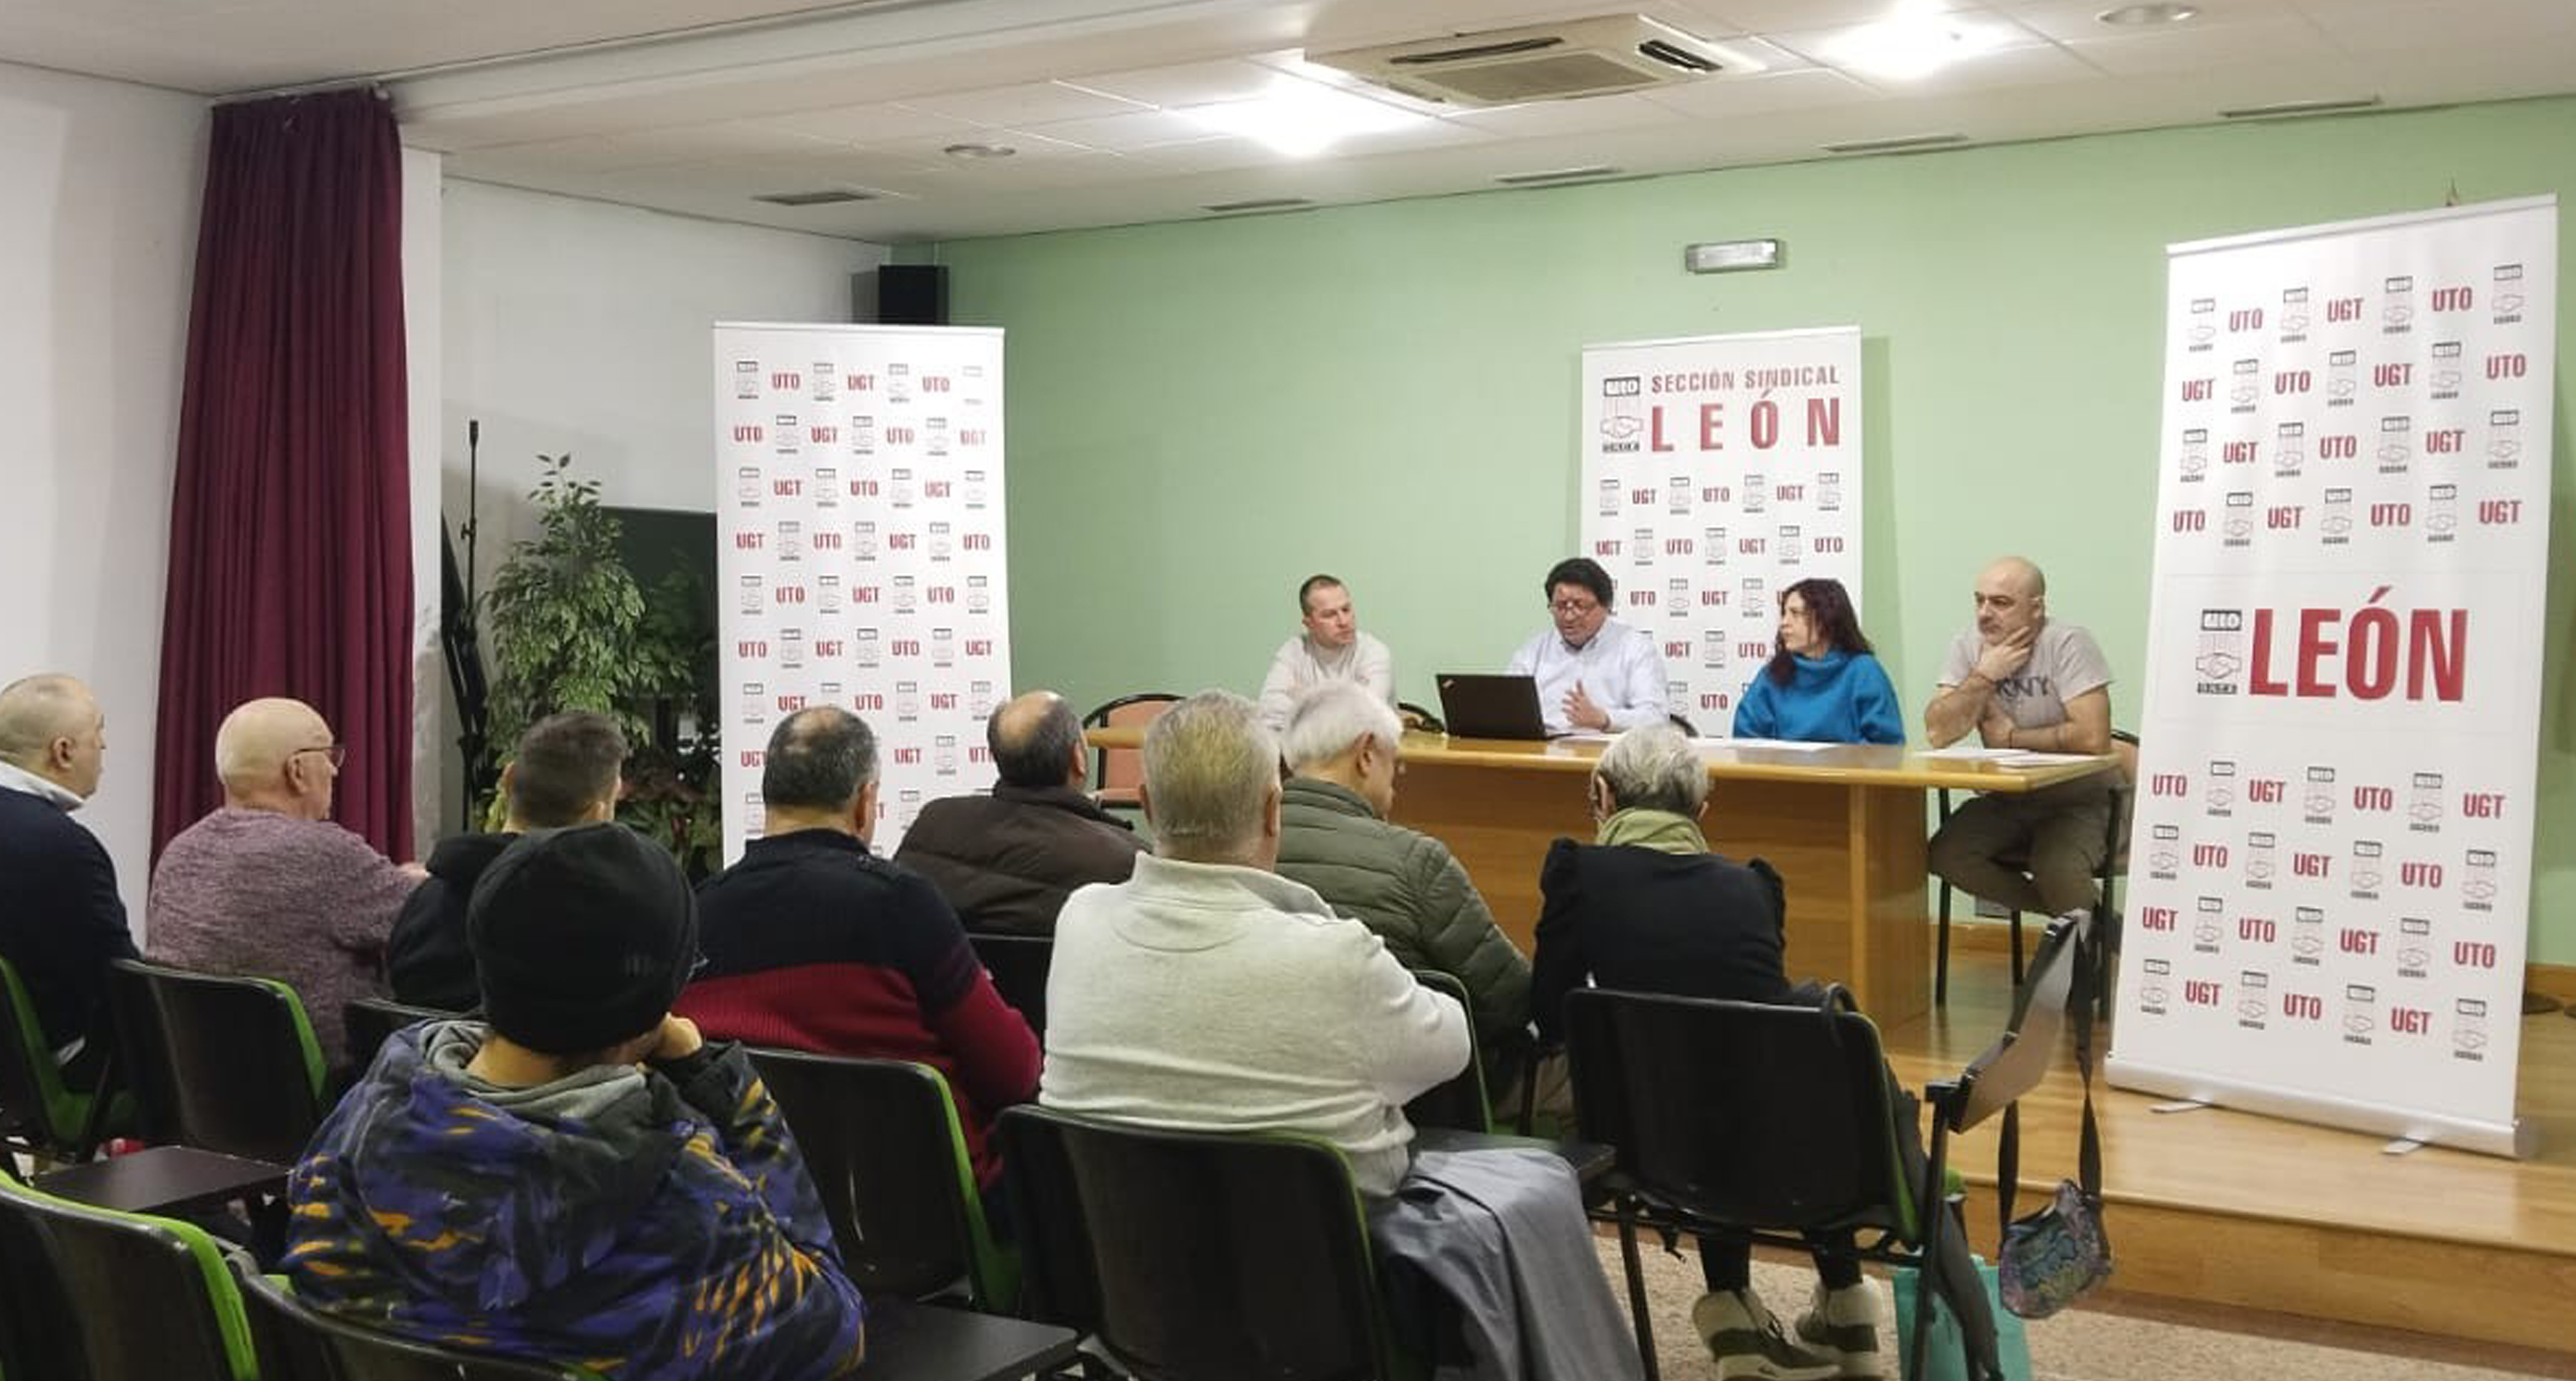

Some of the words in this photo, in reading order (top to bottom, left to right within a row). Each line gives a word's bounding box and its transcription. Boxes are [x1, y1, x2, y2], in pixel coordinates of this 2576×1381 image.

[2229, 308, 2263, 332] UTO
[2327, 297, 2364, 323] UGT
[2432, 286, 2472, 312] UTO
[772, 373, 800, 389] UTO
[847, 374, 874, 391] UGT
[922, 376, 950, 392] UTO
[1652, 370, 1734, 393] SECCIÓN
[1745, 366, 1839, 389] SINDICAL
[2182, 379, 2215, 402] UGT
[2274, 371, 2311, 395] UTO
[2374, 363, 2412, 387] UGT
[2486, 354, 2526, 380] UTO
[734, 426, 762, 442] UTO
[811, 426, 837, 443] UGT
[886, 427, 915, 445] UTO
[2224, 442, 2258, 463] UGT
[2319, 435, 2357, 459] UTO
[2426, 429, 2466, 454] UGT
[774, 479, 801, 495] UGT
[850, 480, 878, 496] UTO
[925, 481, 951, 498] UGT
[1632, 489, 1656, 504] UGT
[1702, 487, 1730, 503] UTO
[1777, 485, 1804, 500] UGT
[2174, 510, 2205, 532] UTO
[2268, 506, 2303, 529] UGT
[2371, 503, 2411, 527] UTO
[2479, 500, 2522, 524] UGT
[736, 532, 764, 549] UGT
[813, 533, 841, 550] UTO
[889, 533, 916, 550] UGT
[963, 534, 990, 550] UTO
[1595, 540, 1621, 556] UGT
[1666, 539, 1693, 555] UTO
[1739, 538, 1765, 554] UGT
[1815, 537, 1844, 553] UTO
[776, 586, 805, 604] UTO
[852, 587, 880, 603] UGT
[927, 587, 954, 603] UTO
[1630, 591, 1656, 606] UTO
[1702, 590, 1728, 606] UGT
[738, 641, 767, 658] UTO
[816, 640, 843, 657] UGT
[892, 640, 920, 656] UTO
[965, 640, 992, 656] UGT
[1665, 641, 1690, 658] UGT
[1738, 643, 1765, 658] UTO
[2250, 586, 2468, 702] LEÓN
[778, 696, 805, 711] UGT
[854, 694, 883, 711] UTO
[930, 693, 958, 709] UGT
[1701, 694, 1728, 710] UTO
[894, 748, 921, 764] UGT
[2152, 775, 2187, 797] UTO
[2249, 780, 2286, 803] UGT
[2353, 786, 2393, 811] UTO
[2463, 793, 2506, 819] UGT
[2193, 844, 2228, 868] UTO
[2294, 853, 2332, 878] UGT
[2401, 862, 2443, 889] UTO
[2142, 907, 2178, 931] UGT
[2239, 918, 2276, 943] UTO
[2340, 928, 2379, 955] UGT
[2454, 941, 2496, 969] UTO
[2185, 981, 2221, 1006] UGT
[2284, 994, 2321, 1021] UTO
[2390, 1007, 2432, 1035] UGT
